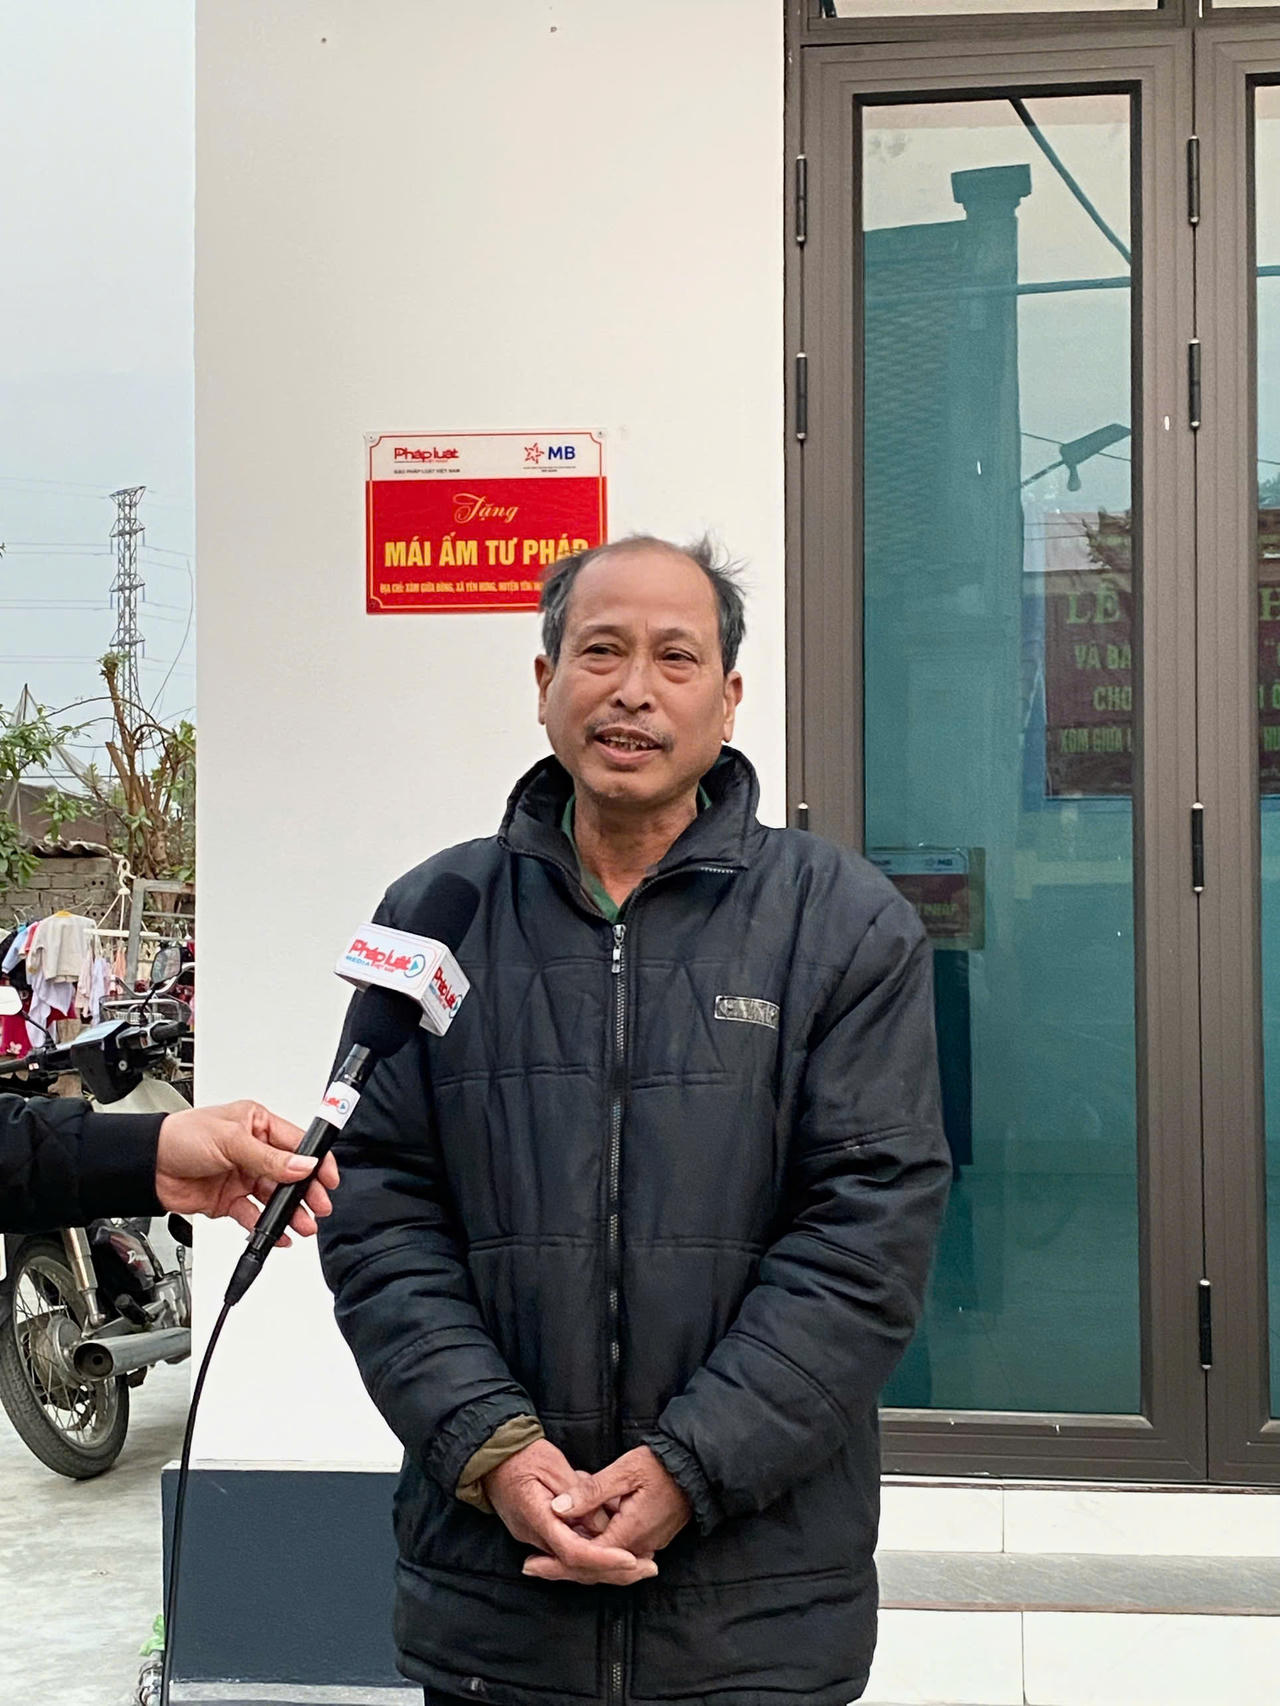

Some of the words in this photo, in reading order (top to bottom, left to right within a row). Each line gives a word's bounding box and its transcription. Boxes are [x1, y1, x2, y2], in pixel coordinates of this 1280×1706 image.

[548, 446, 576, 460] MB
[453, 493, 519, 524] Tặng
[384, 536, 431, 567] MÁI
[439, 531, 478, 567] ẤM
[485, 537, 518, 565] TƯ
